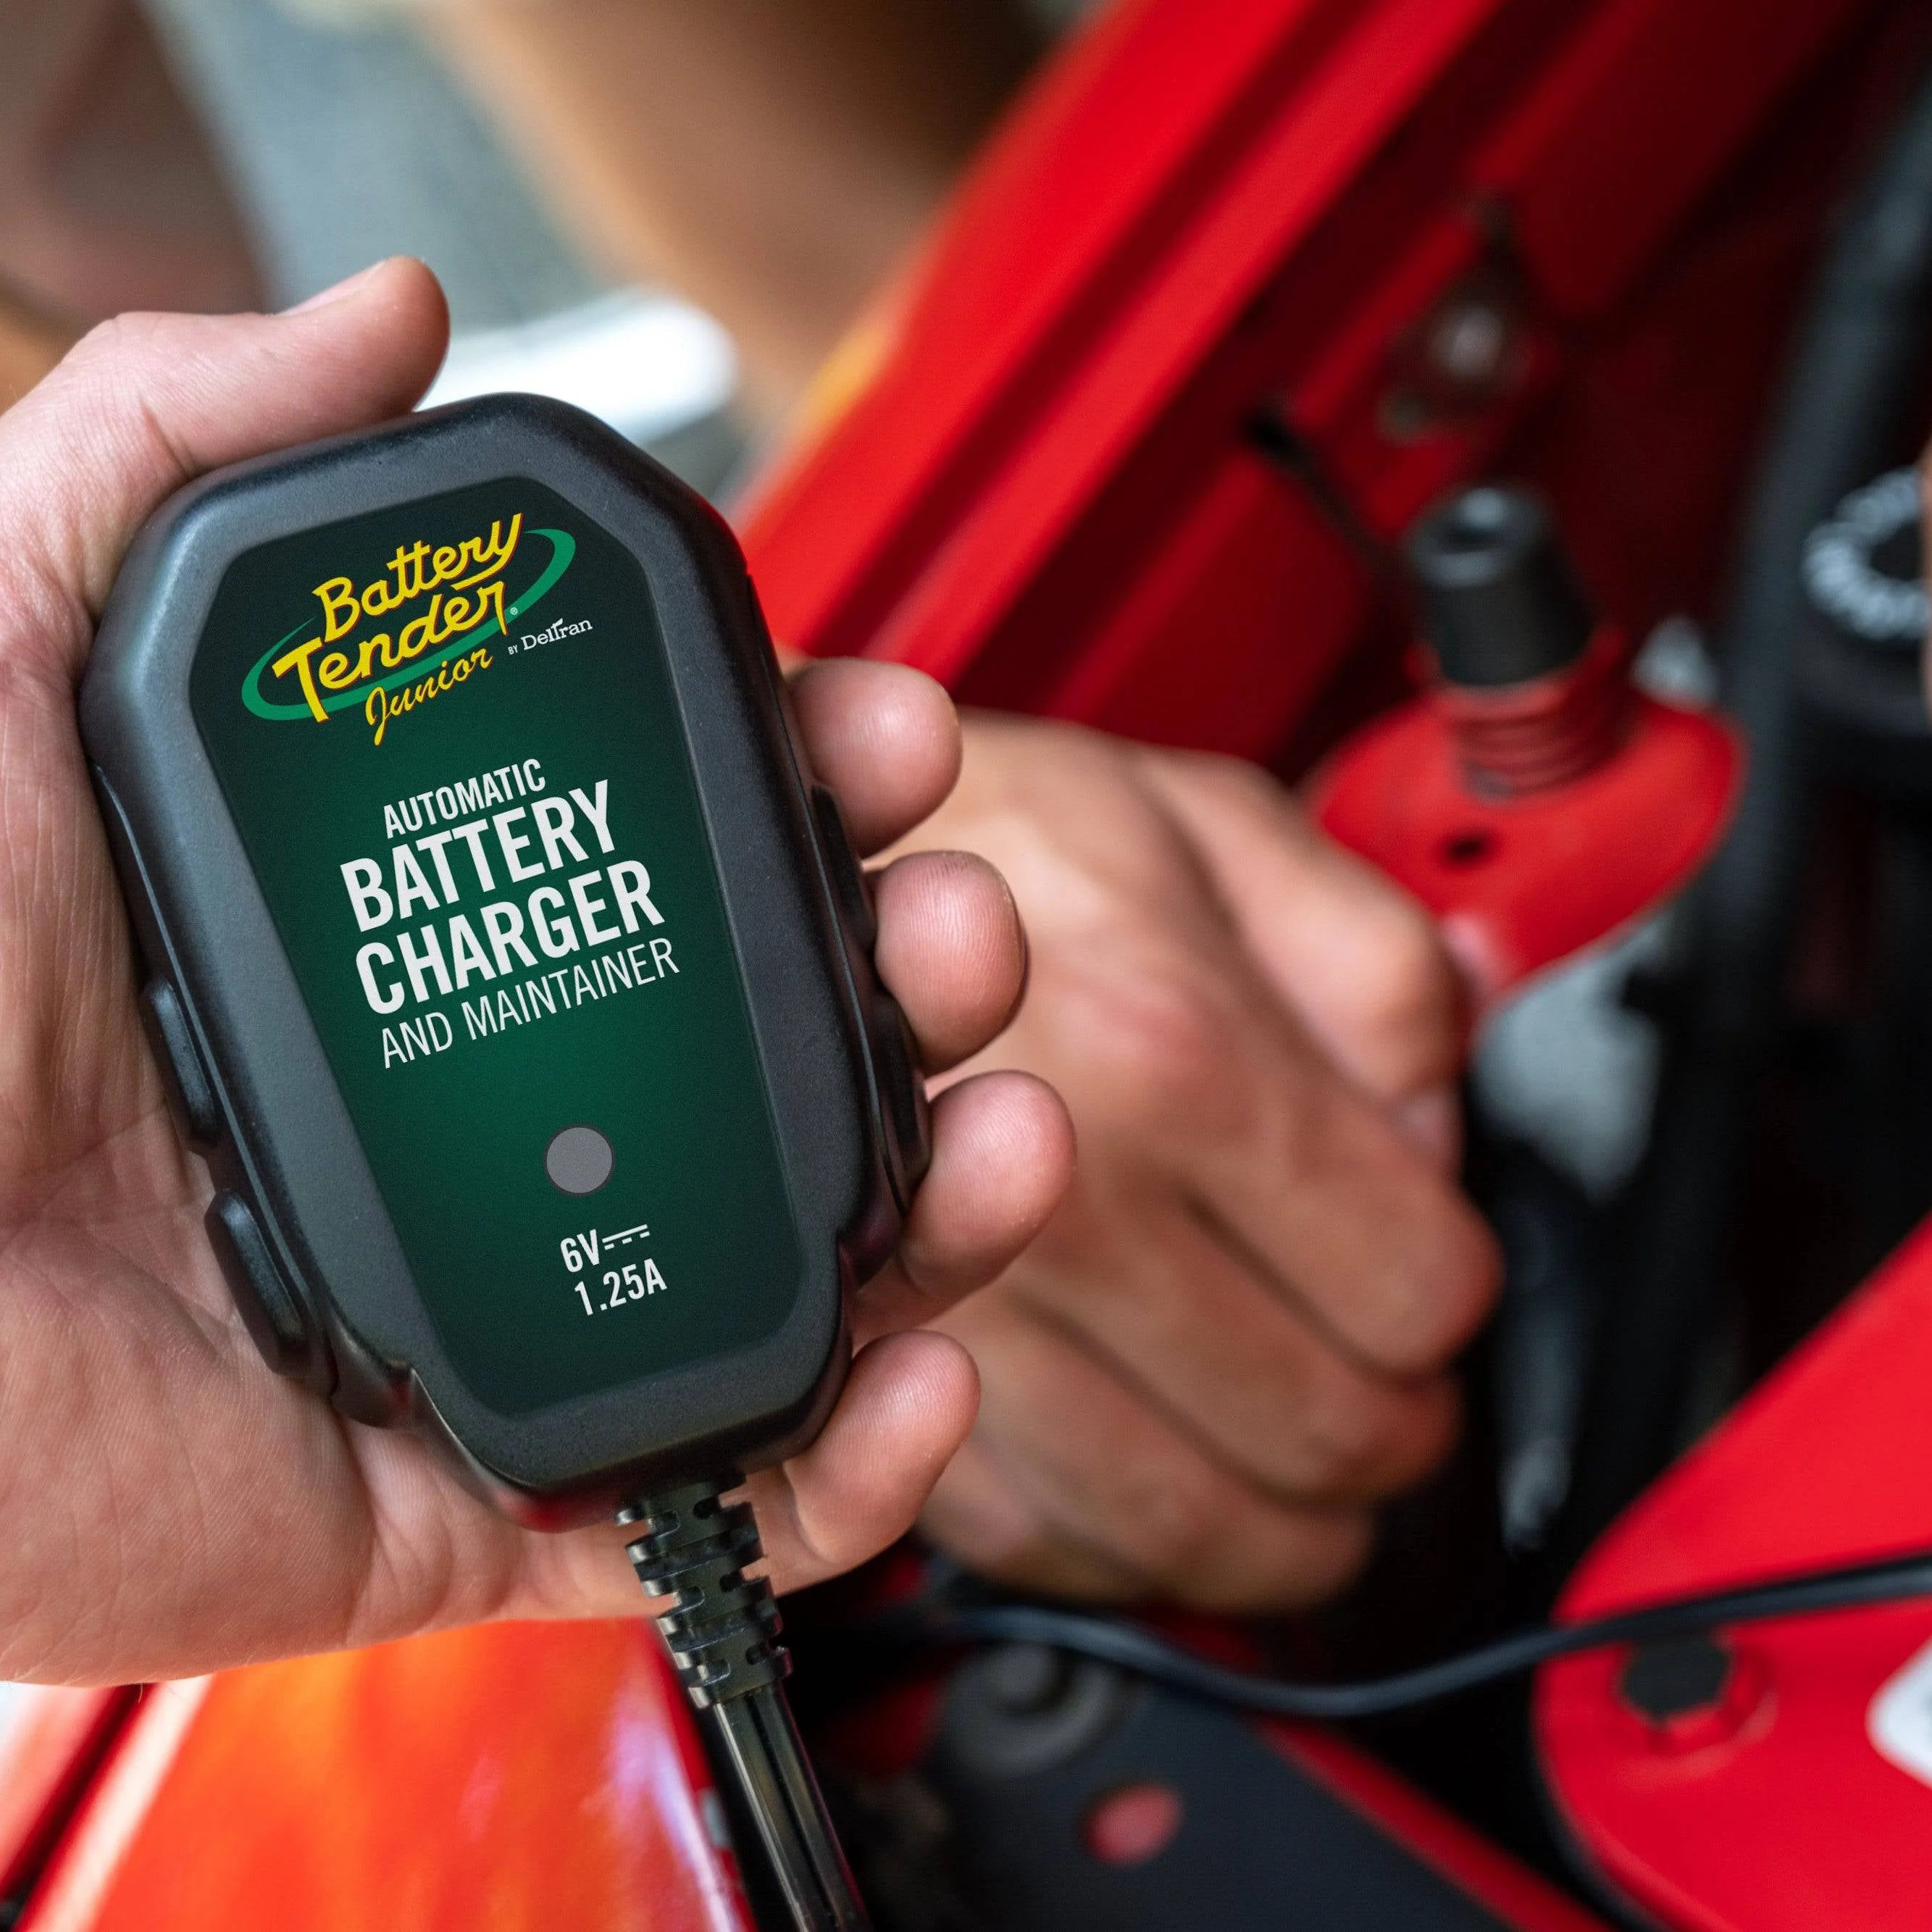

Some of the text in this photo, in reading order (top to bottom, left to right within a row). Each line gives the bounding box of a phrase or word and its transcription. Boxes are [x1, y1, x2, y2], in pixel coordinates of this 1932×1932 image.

[312, 512, 524, 643] Battery
[271, 580, 509, 724] Tender
[365, 648, 494, 746] Junior
[507, 644, 518, 655] BY
[340, 779, 616, 932] BATTERY
[382, 758, 546, 839] AUTOMATIC
[355, 860, 666, 1015] CHARGER
[381, 937, 680, 1069] AND MAINTAINER
[574, 1258, 668, 1316] 1.25A
